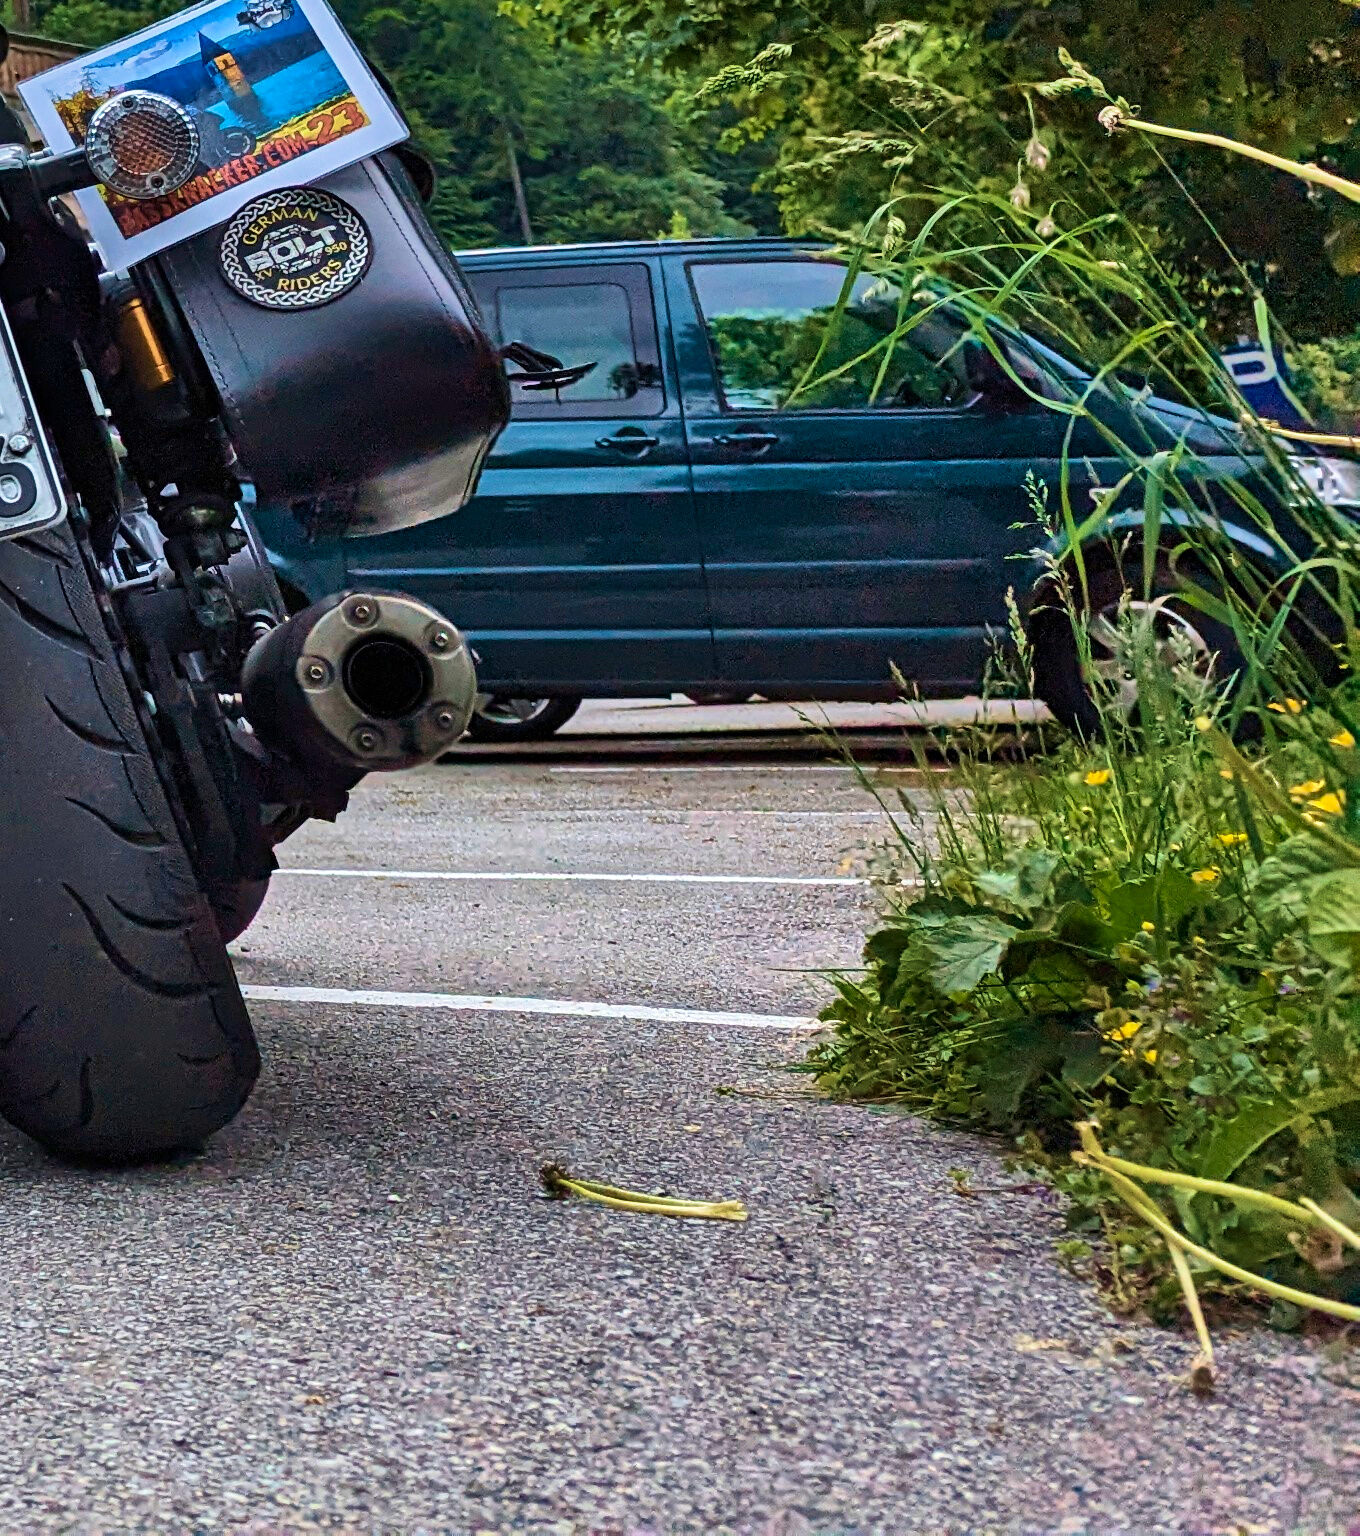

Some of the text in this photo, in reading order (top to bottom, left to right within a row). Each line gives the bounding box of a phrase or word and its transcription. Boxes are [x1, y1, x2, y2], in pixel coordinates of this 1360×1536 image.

[242, 206, 319, 246] GERMAN
[243, 225, 337, 273] BOLT
[324, 241, 348, 256] 950
[276, 259, 343, 291] RIDERS
